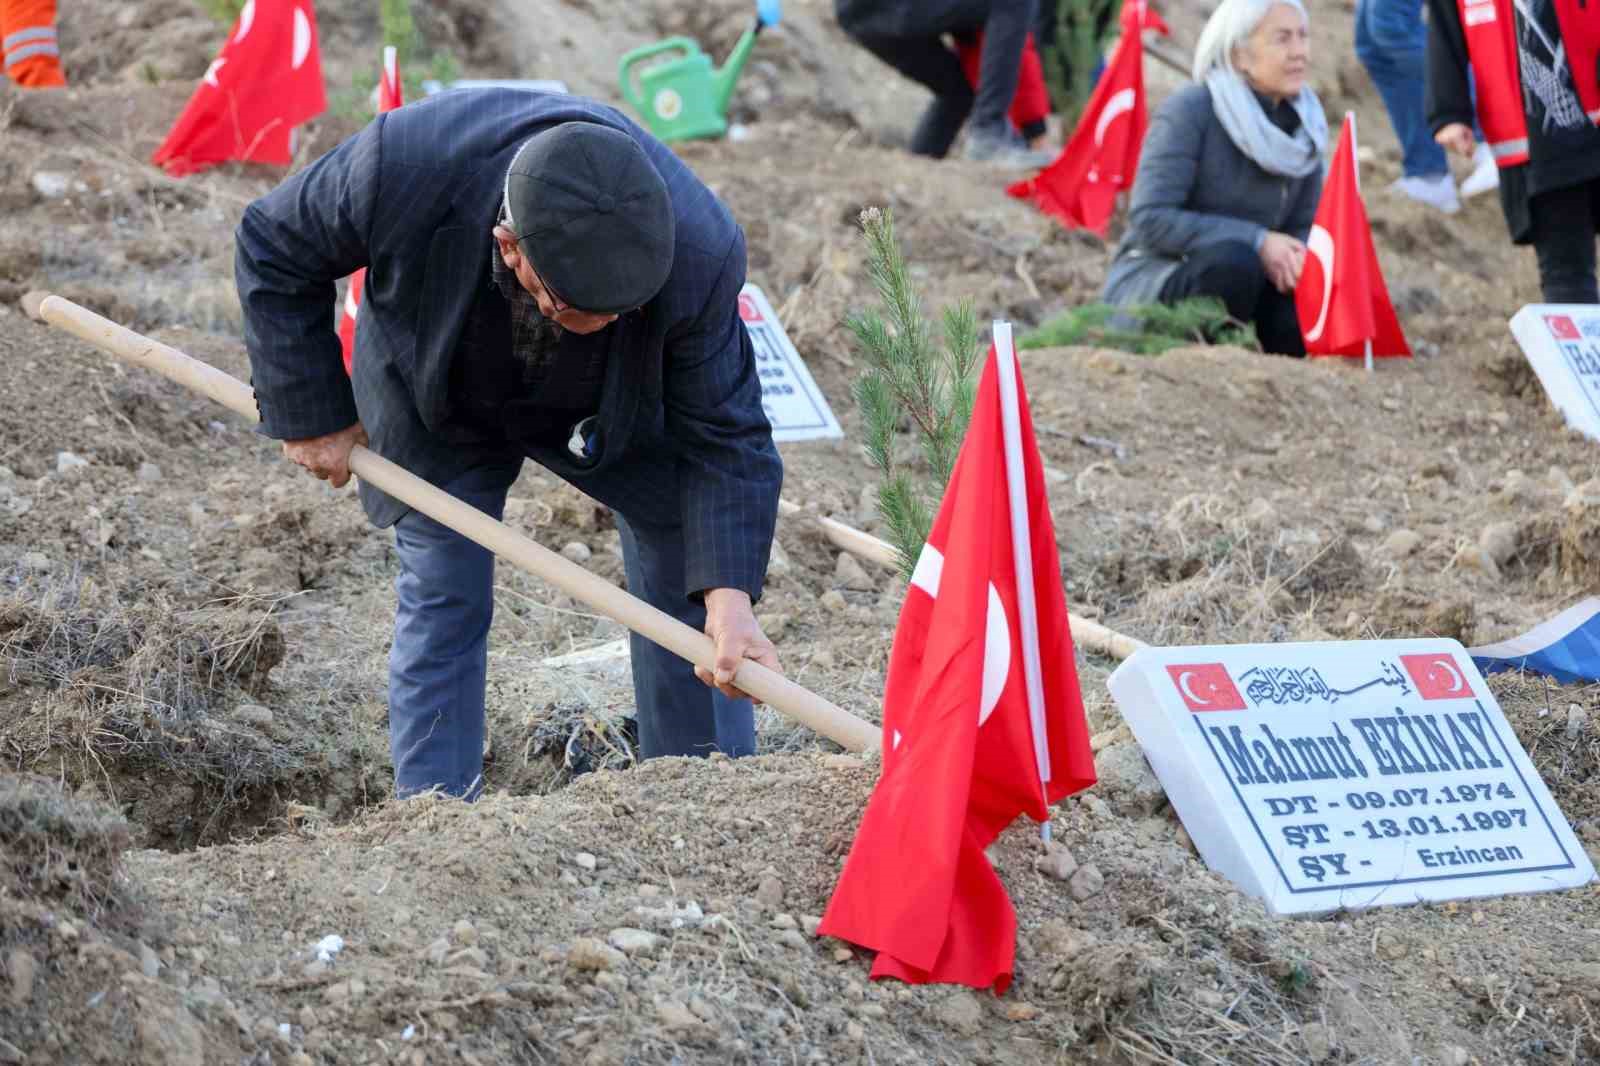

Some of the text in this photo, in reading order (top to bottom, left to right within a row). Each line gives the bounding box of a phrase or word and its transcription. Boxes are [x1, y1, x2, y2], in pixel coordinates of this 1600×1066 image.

[1209, 706, 1503, 785] Mahmut EKİNAY
[1264, 796, 1318, 816] DT
[1346, 782, 1516, 810] 09.07.1974
[1282, 824, 1330, 848] ŞT
[1362, 808, 1527, 839] 13.01.1997
[1298, 853, 1350, 882] ŞY
[1417, 845, 1523, 867] Erzincan
